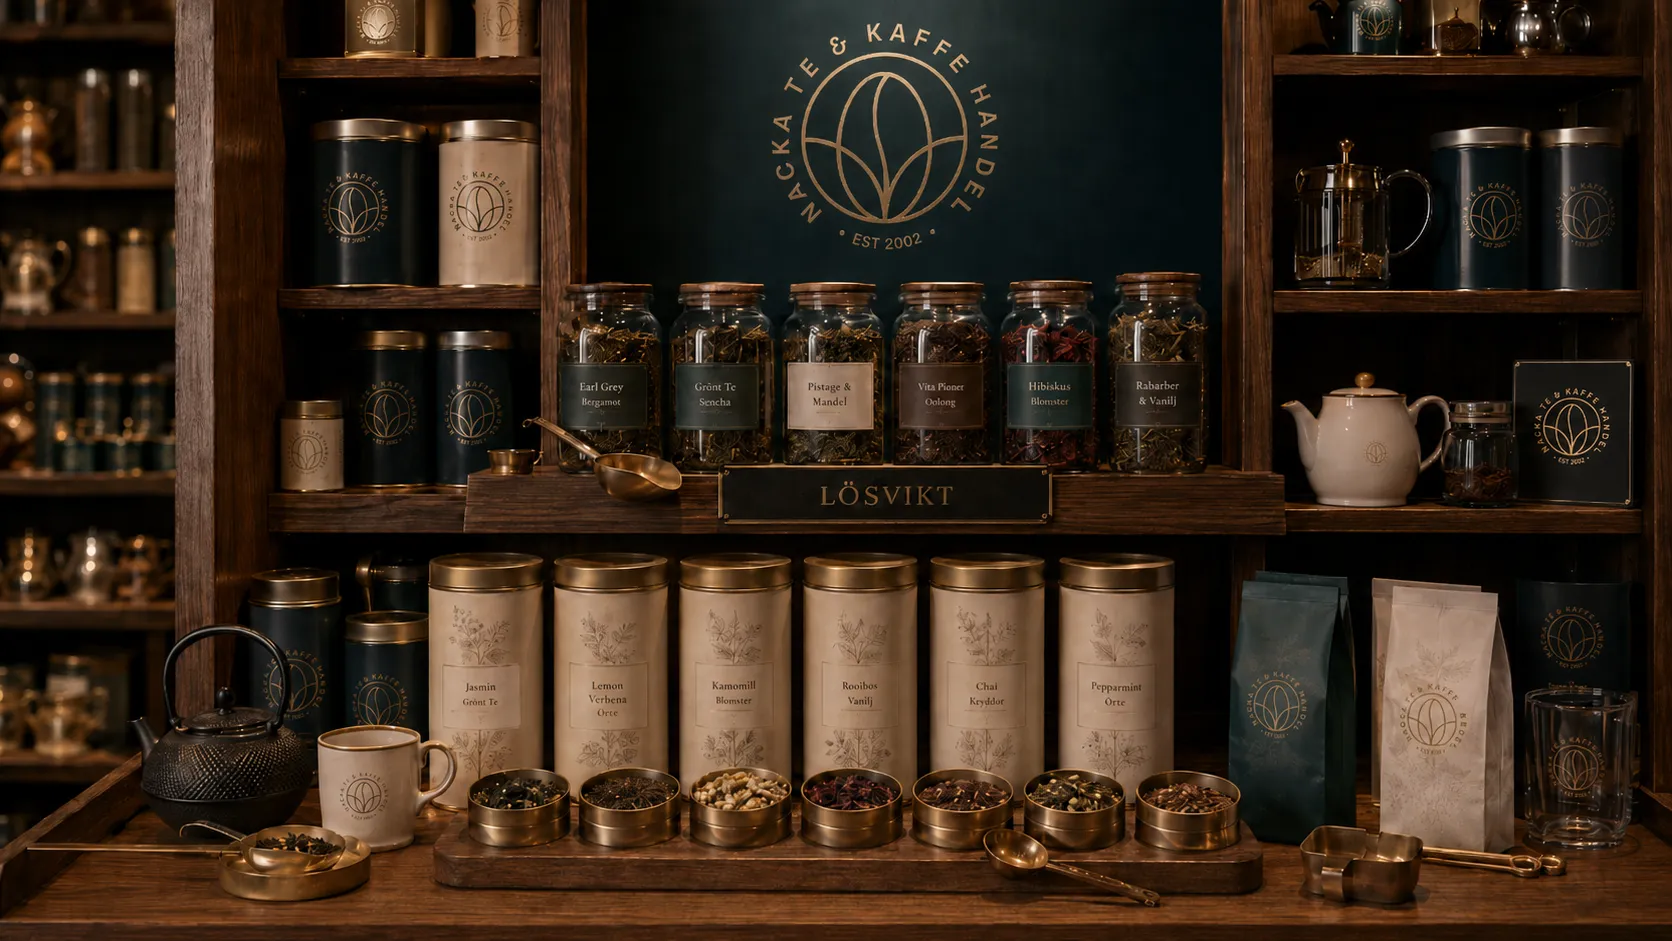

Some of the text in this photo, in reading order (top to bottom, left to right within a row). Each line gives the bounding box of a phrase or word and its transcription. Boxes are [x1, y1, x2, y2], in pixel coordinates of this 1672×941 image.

[772, 22, 999, 224] NACKA TE & KAFFE HANDEL
[345, 172, 379, 188] KAFFE
[472, 172, 506, 188] KAFFE
[852, 232, 922, 250] EST 2002
[580, 382, 624, 394] Earl Grey
[724, 382, 736, 392] Te
[808, 382, 851, 394] Pistage &
[918, 382, 936, 392] Vita
[1028, 382, 1071, 391] Hibiskus
[1136, 380, 1180, 390] Rabarber
[699, 397, 731, 406] Sencha
[813, 396, 846, 406] Mandel
[1565, 388, 1600, 404] KAFFE
[582, 397, 620, 408] Bergamot
[925, 397, 956, 408] Oolong
[1138, 396, 1177, 408] & Vanilj
[1540, 398, 1552, 410] TE
[1534, 415, 1550, 454] NACKA
[1594, 406, 1610, 452] HANDEL
[820, 480, 954, 506] LÖSVIKT
[466, 682, 496, 692] Jasmin
[592, 682, 623, 690] Lemon
[712, 680, 756, 690] Kamomill
[842, 682, 878, 690] Rooibos
[976, 682, 998, 690] Chai
[1092, 682, 1142, 694] Pepparmint
[588, 695, 627, 704] Verbena
[716, 696, 752, 704] Blomster
[848, 696, 872, 708] Vanilj
